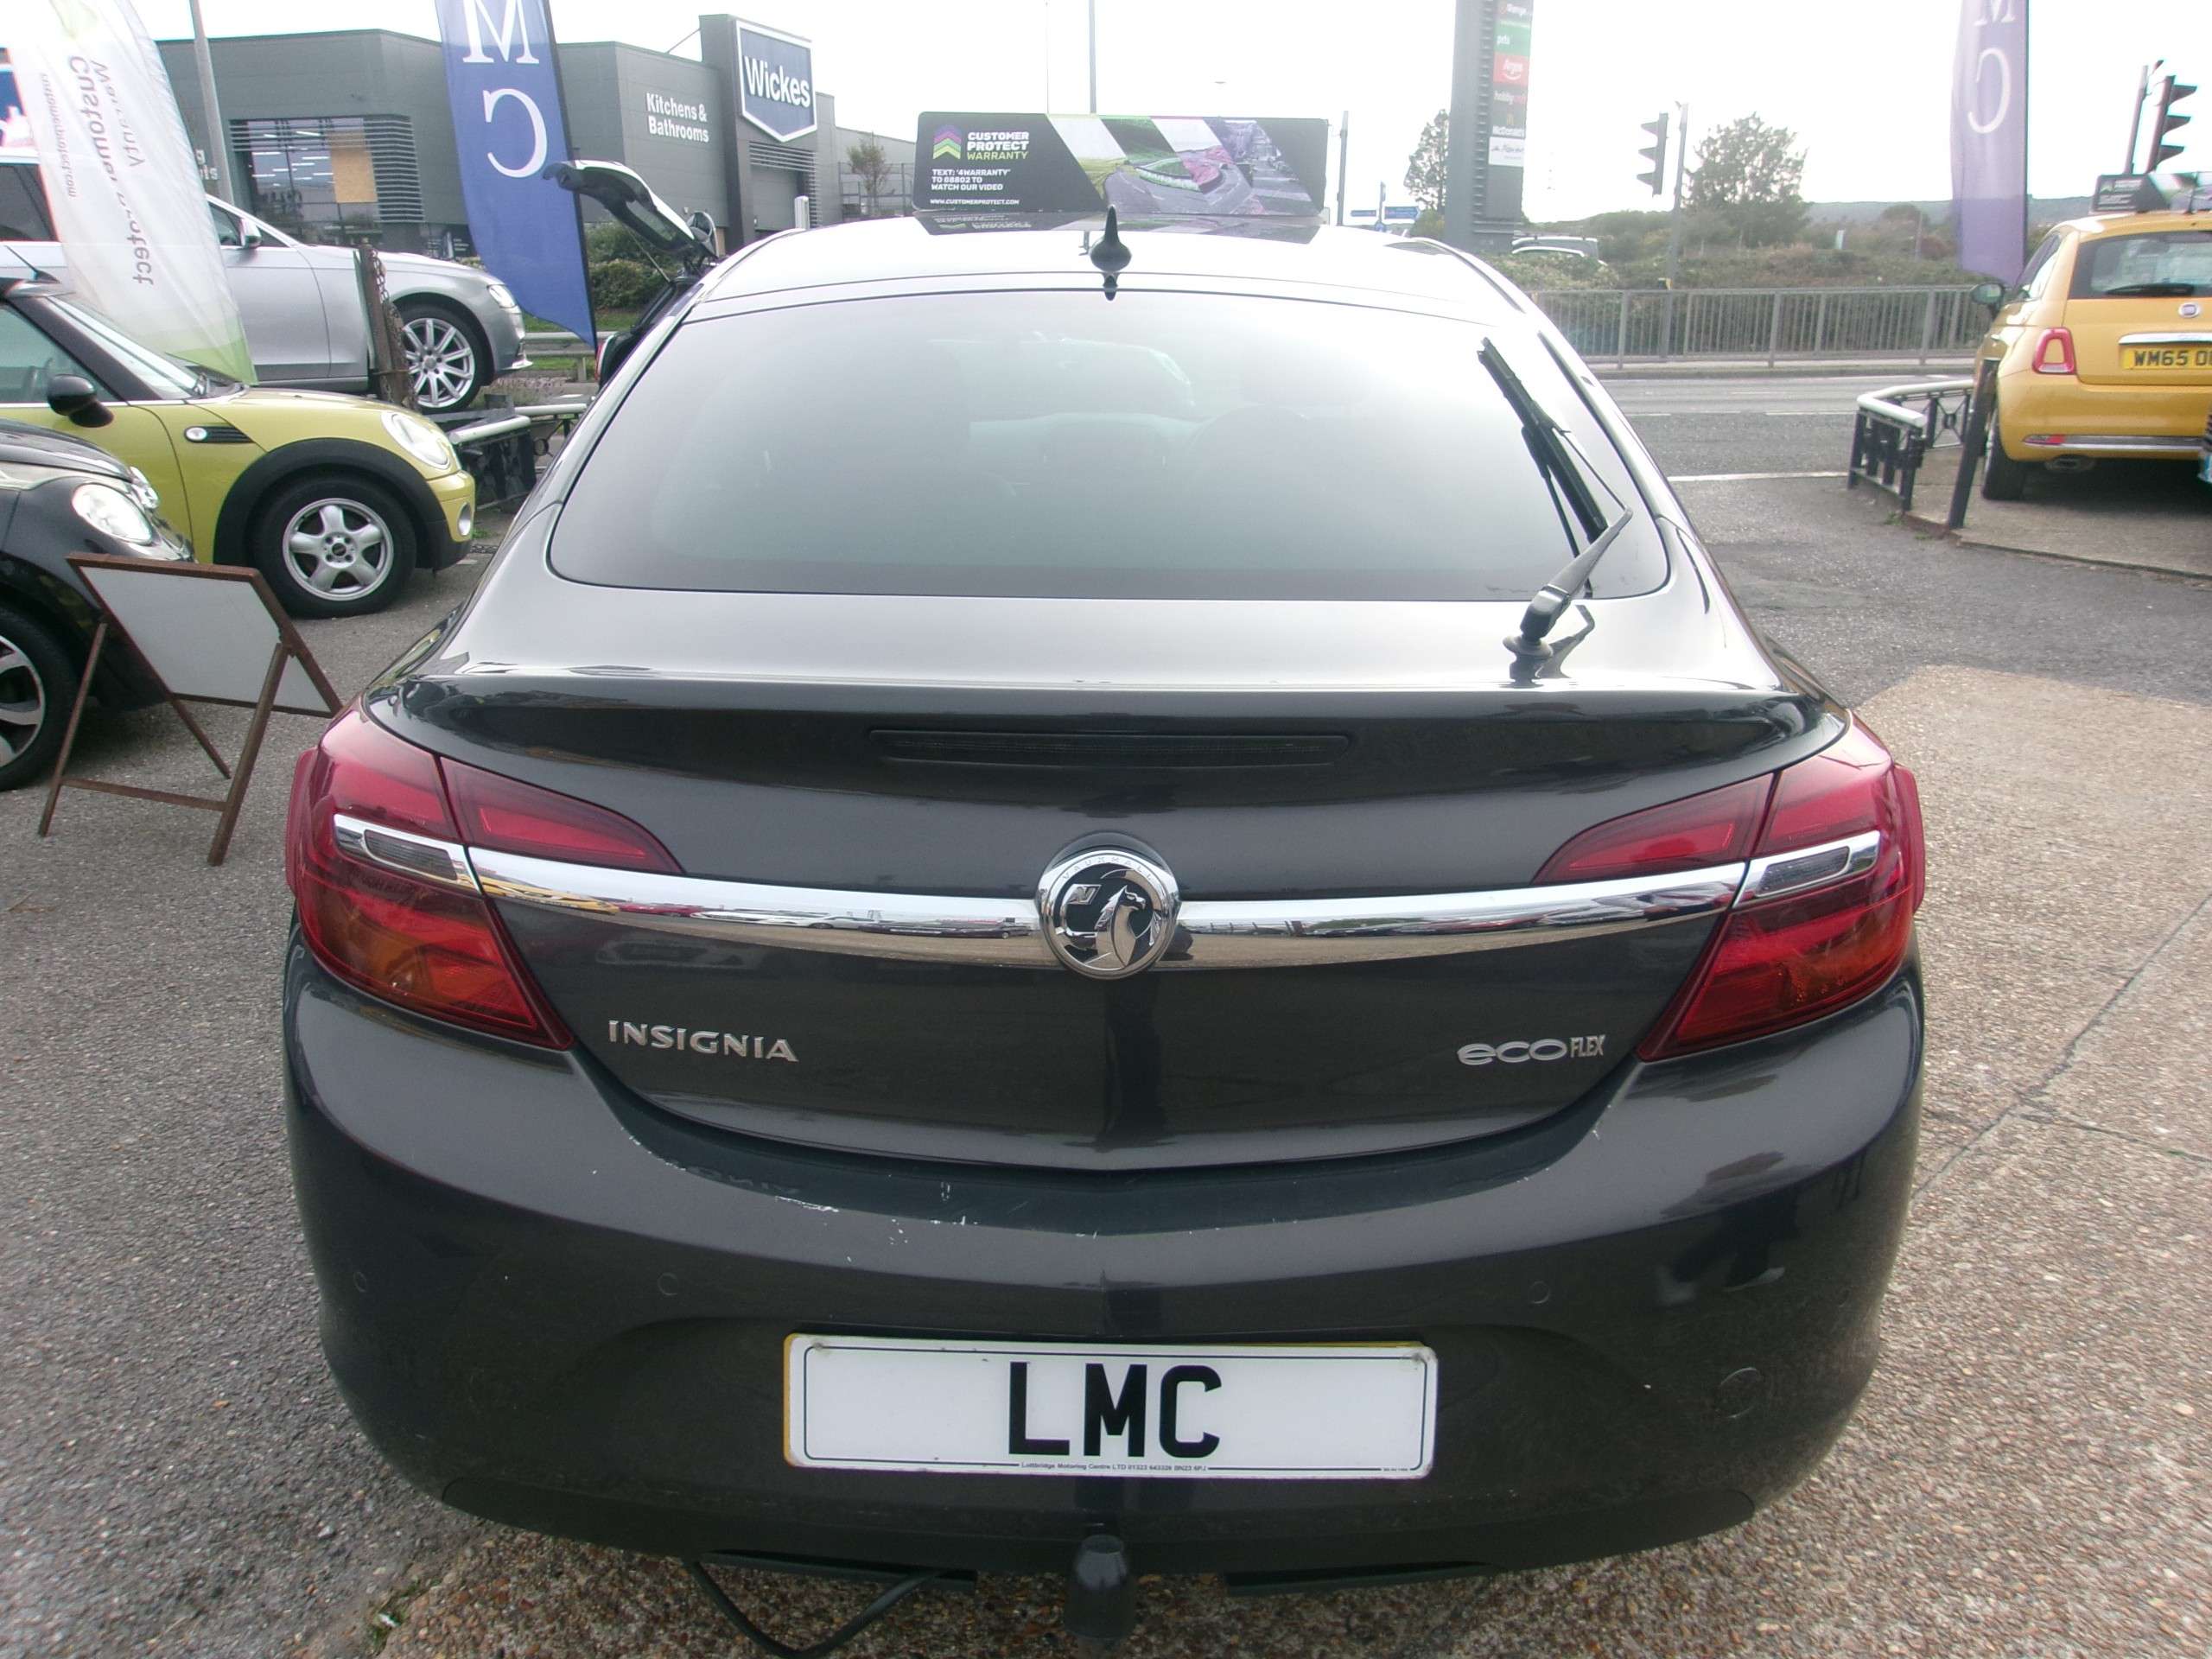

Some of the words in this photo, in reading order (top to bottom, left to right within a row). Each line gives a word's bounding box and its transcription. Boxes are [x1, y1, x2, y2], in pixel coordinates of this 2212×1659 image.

[744, 55, 811, 108] Wickes
[646, 92, 697, 119] Kitchens
[698, 103, 708, 123] &
[648, 115, 709, 143] Bathrooms
[967, 131, 1030, 141] CUSTOMER
[967, 141, 1030, 151] PROTECT
[967, 151, 1029, 161] WARRANTY
[2133, 349, 2190, 367] WM65
[1062, 856, 1153, 880] VAUXHALL
[607, 1020, 799, 1063] INSIGNIA
[1008, 1361, 1223, 1459] LMC
